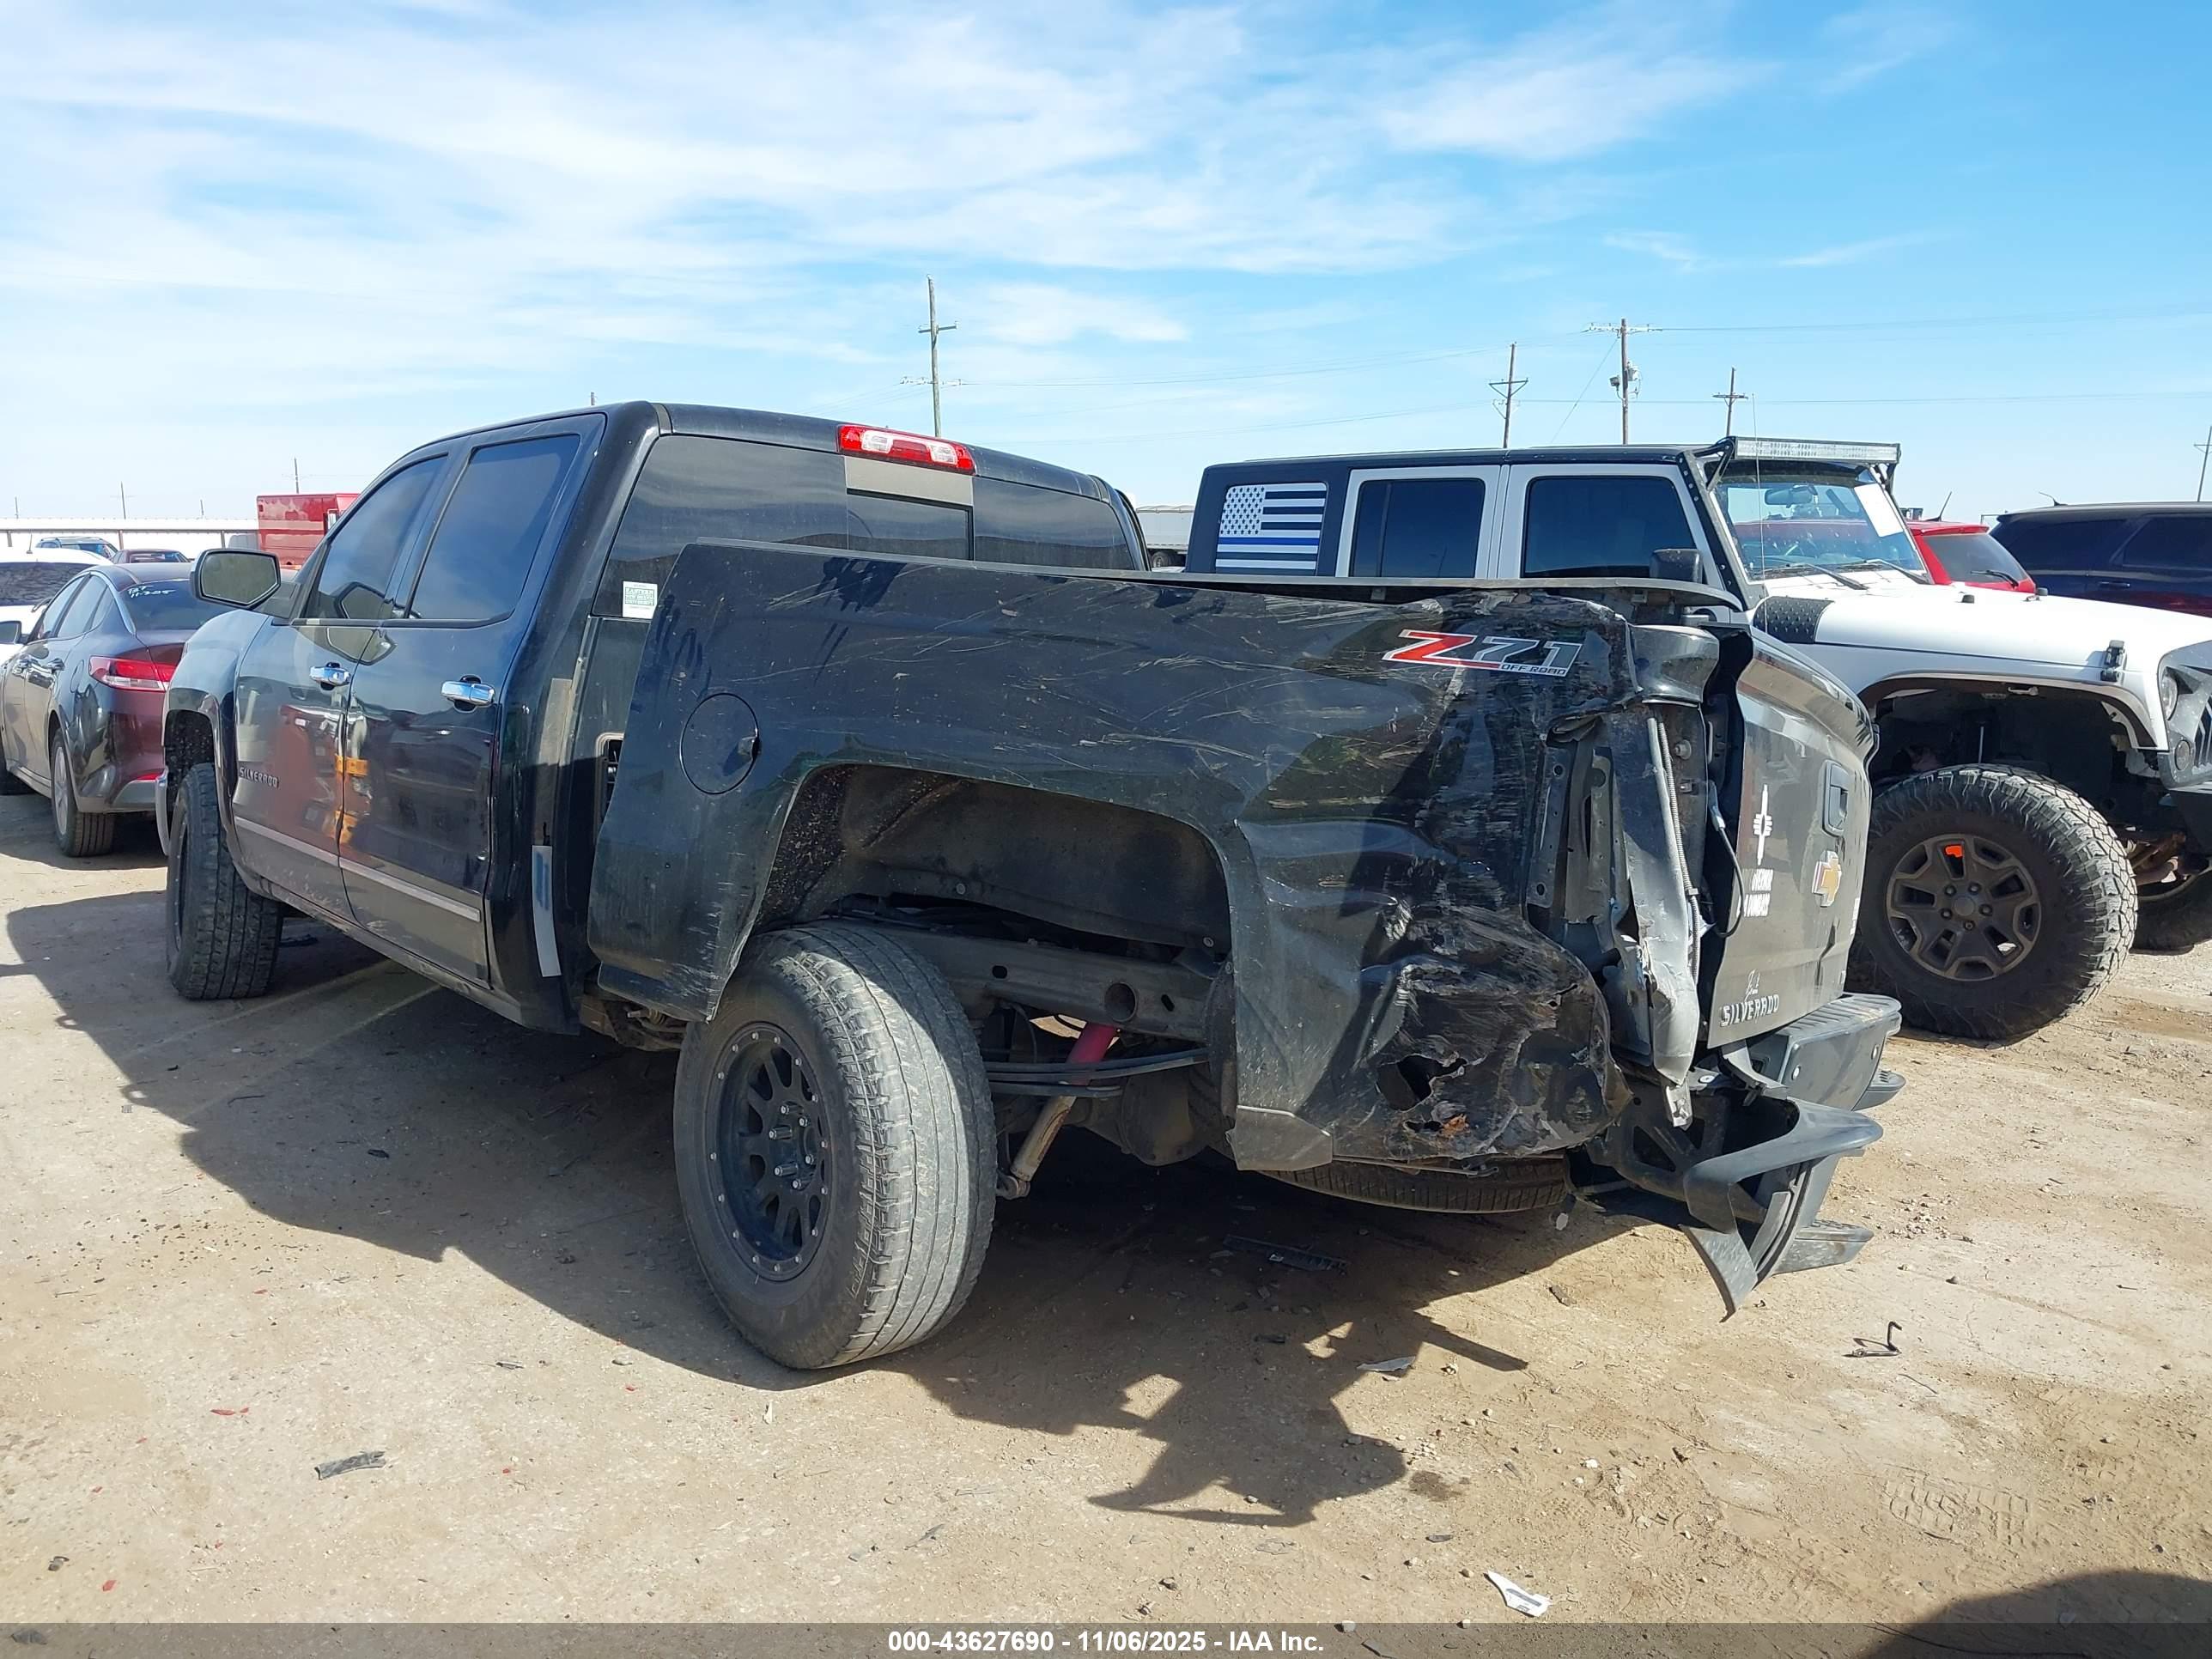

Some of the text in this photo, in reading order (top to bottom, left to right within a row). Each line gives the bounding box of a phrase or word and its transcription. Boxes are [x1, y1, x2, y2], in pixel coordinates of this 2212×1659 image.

[1382, 629, 1583, 673] Z71
[1529, 665, 1566, 676] ROAD
[240, 766, 279, 788] SILVERADO
[1720, 994, 1779, 1027] SILVERADO
